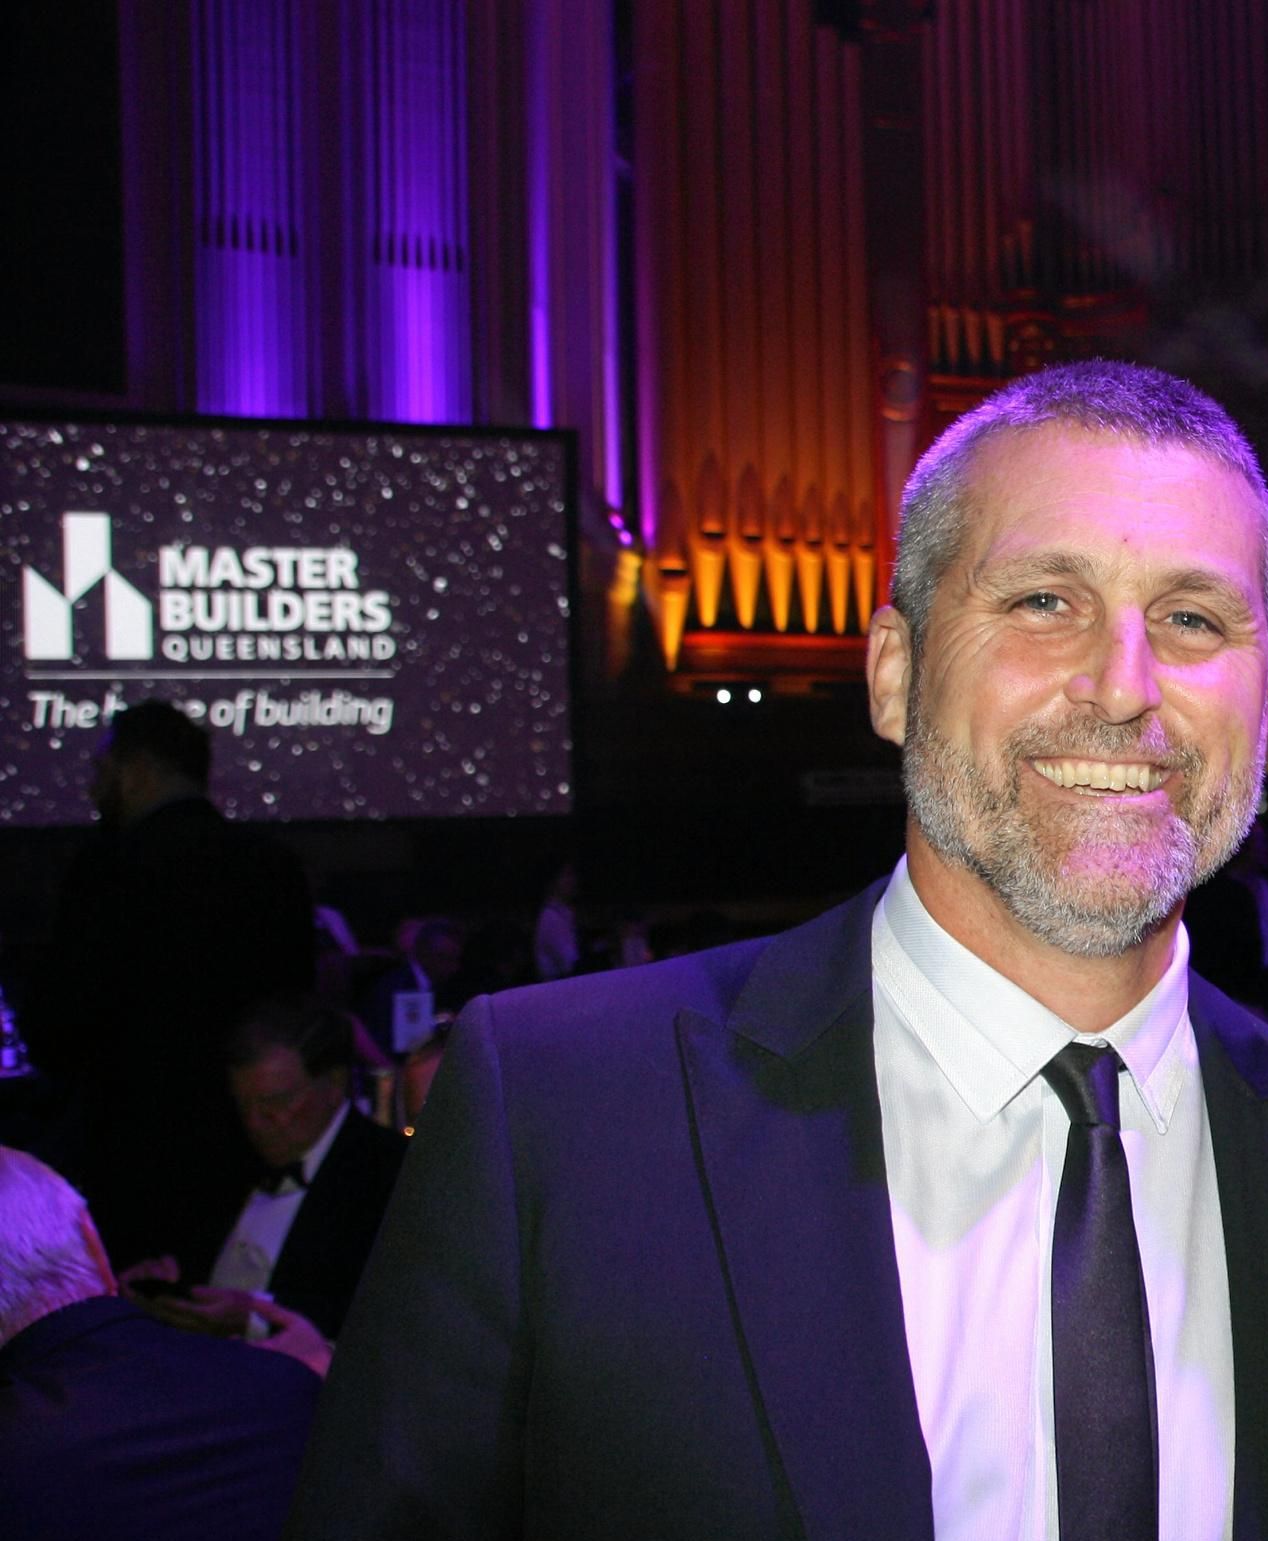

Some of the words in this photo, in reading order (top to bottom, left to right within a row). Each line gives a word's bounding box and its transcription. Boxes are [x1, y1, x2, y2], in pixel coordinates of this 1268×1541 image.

[159, 546, 358, 589] MASTER
[159, 589, 392, 633] BUILDERS
[162, 634, 396, 662] QUEENSLAND
[27, 690, 98, 728] The
[209, 689, 254, 736] of
[254, 688, 394, 736] building
